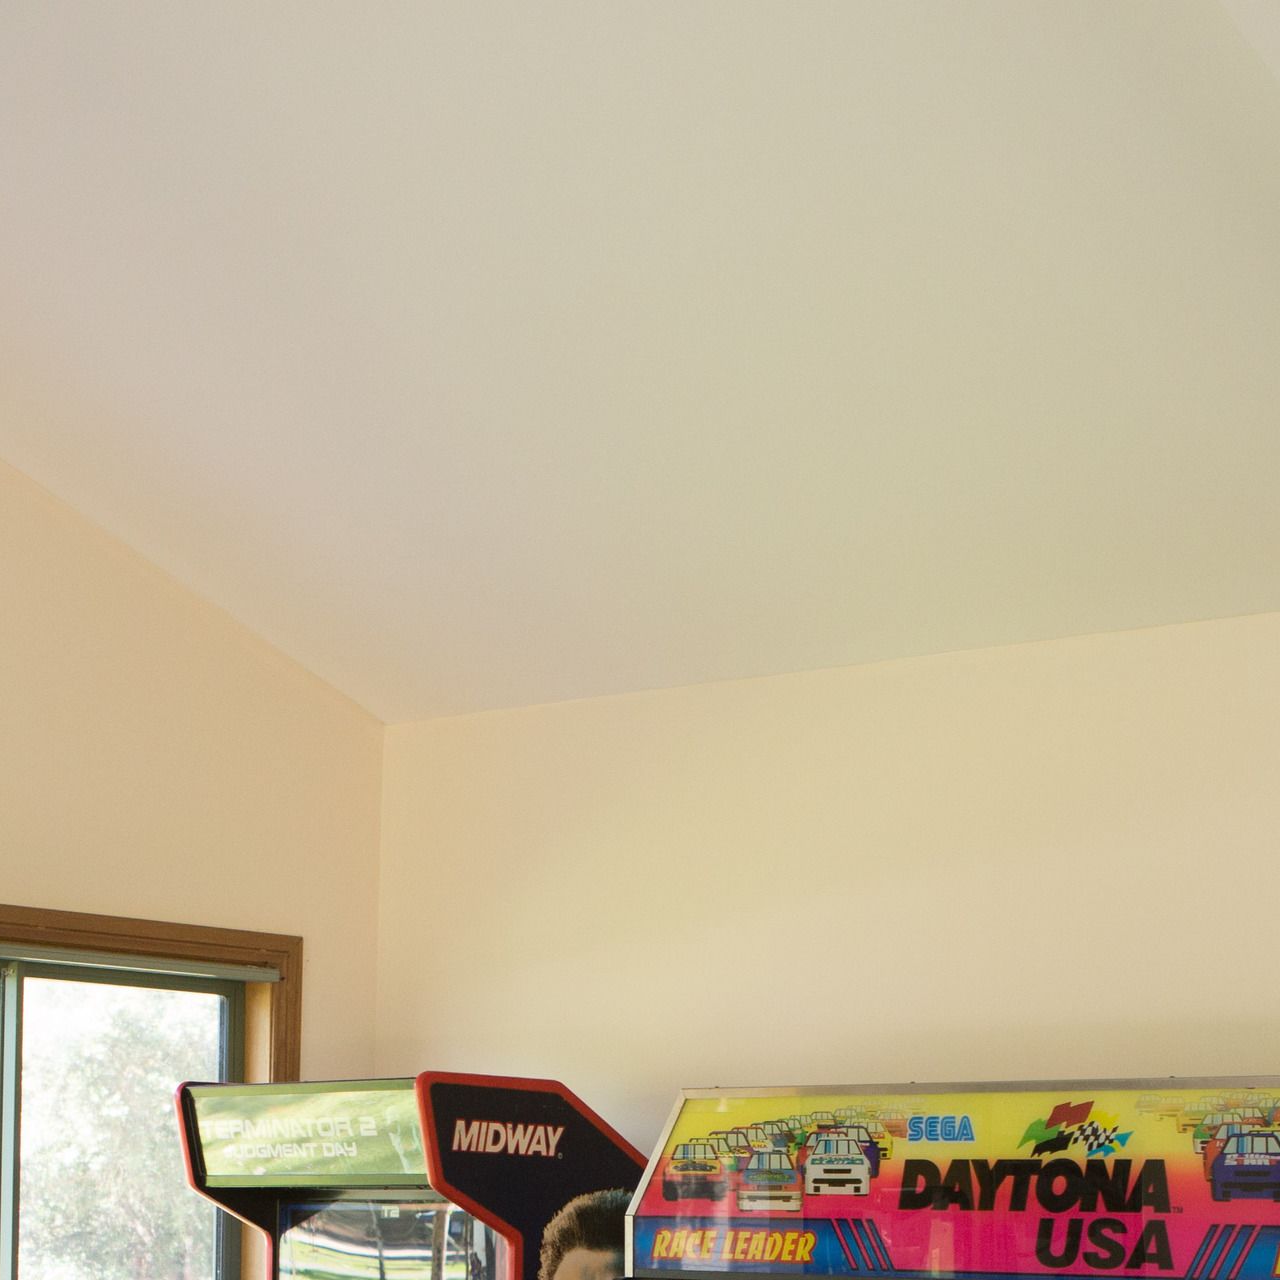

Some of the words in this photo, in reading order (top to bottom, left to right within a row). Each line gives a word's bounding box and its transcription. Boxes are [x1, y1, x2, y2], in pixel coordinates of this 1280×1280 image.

[200, 1118, 353, 1141] TERMINATOR
[361, 1116, 378, 1137] 2
[452, 1119, 564, 1157] MIDWAY
[907, 1115, 975, 1142] SEGA
[224, 1143, 318, 1159] JUDGMENT
[323, 1142, 357, 1157] DAY
[898, 1158, 1171, 1214] DAYTONA
[652, 1229, 718, 1259] RACE
[722, 1230, 816, 1262] LEADER
[1035, 1218, 1174, 1270] USA
